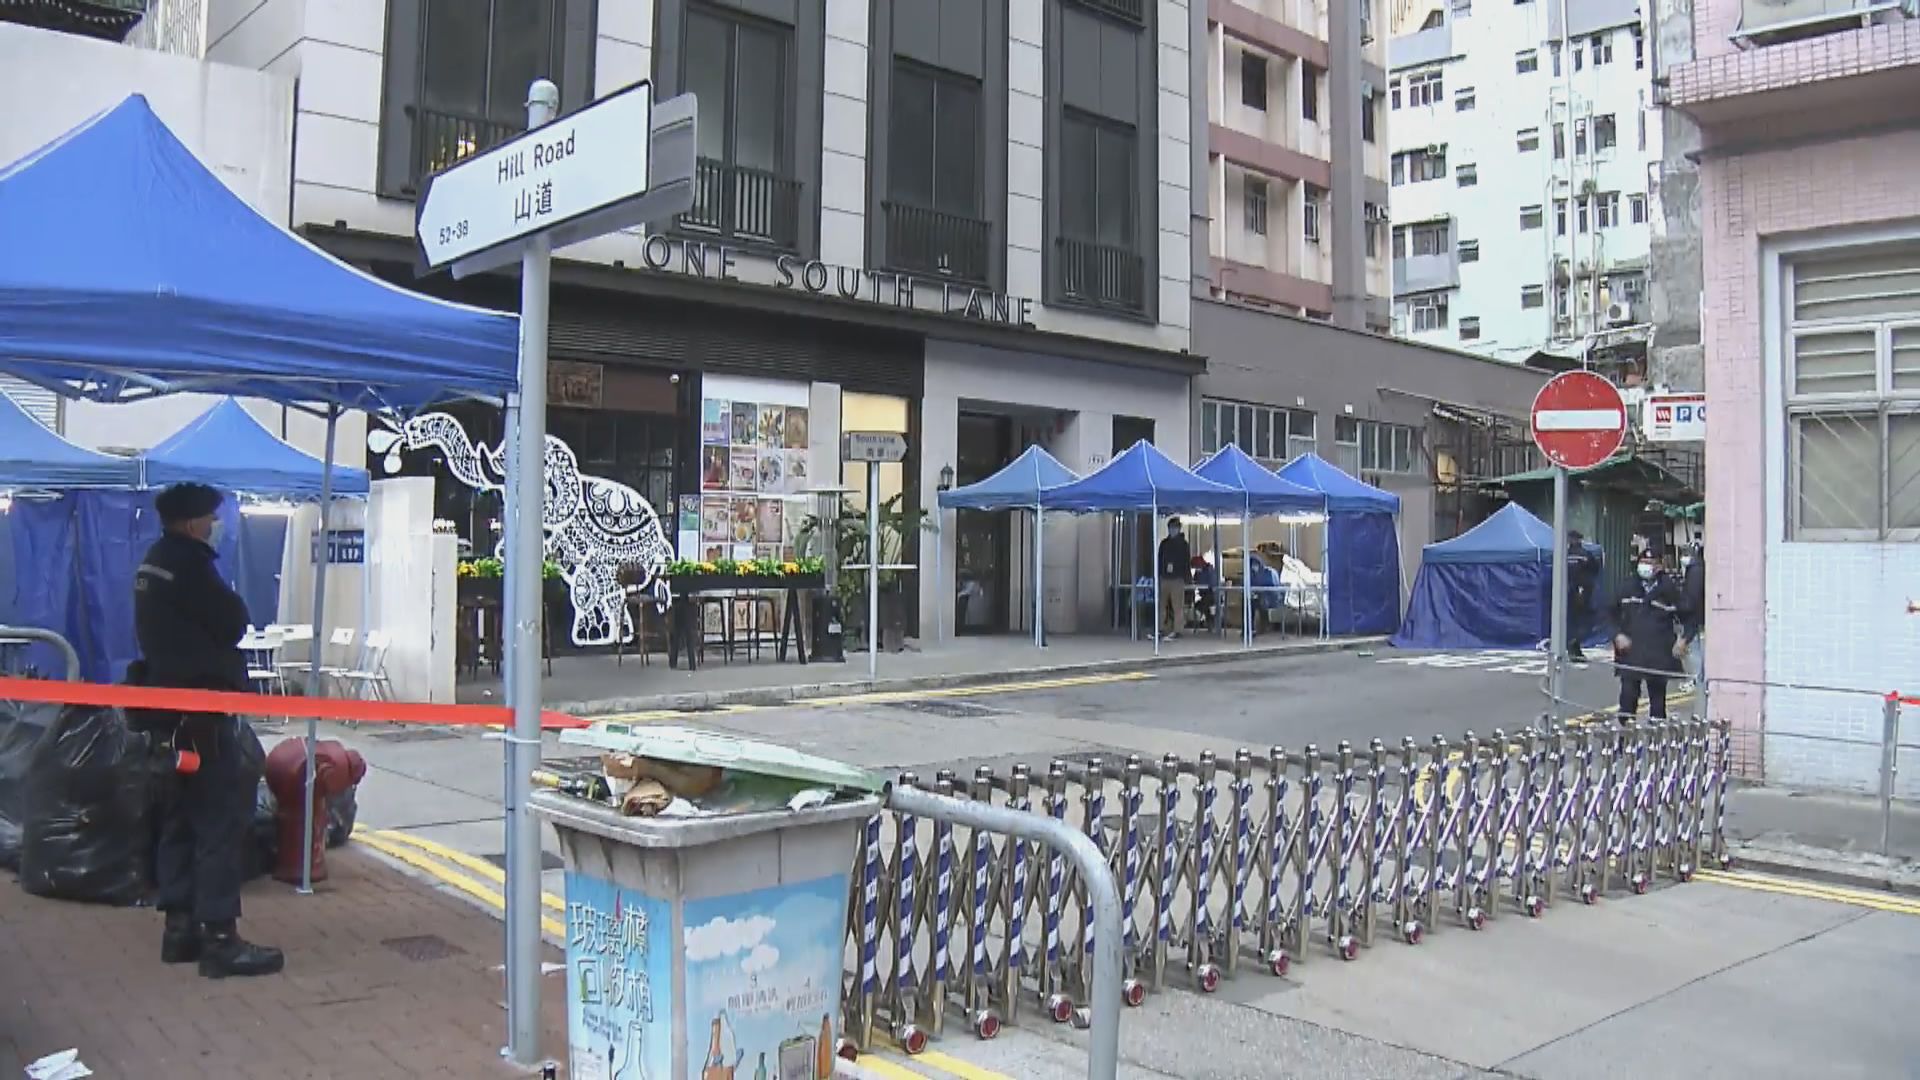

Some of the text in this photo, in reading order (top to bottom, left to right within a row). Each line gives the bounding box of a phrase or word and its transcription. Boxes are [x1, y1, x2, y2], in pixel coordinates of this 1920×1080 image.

[498, 129, 576, 184] Hill Road
[514, 181, 553, 224] 山道
[439, 219, 469, 246] 52-38
[642, 233, 1034, 326] ONE SOUTH LANE
[569, 901, 650, 963] 玻璃樽
